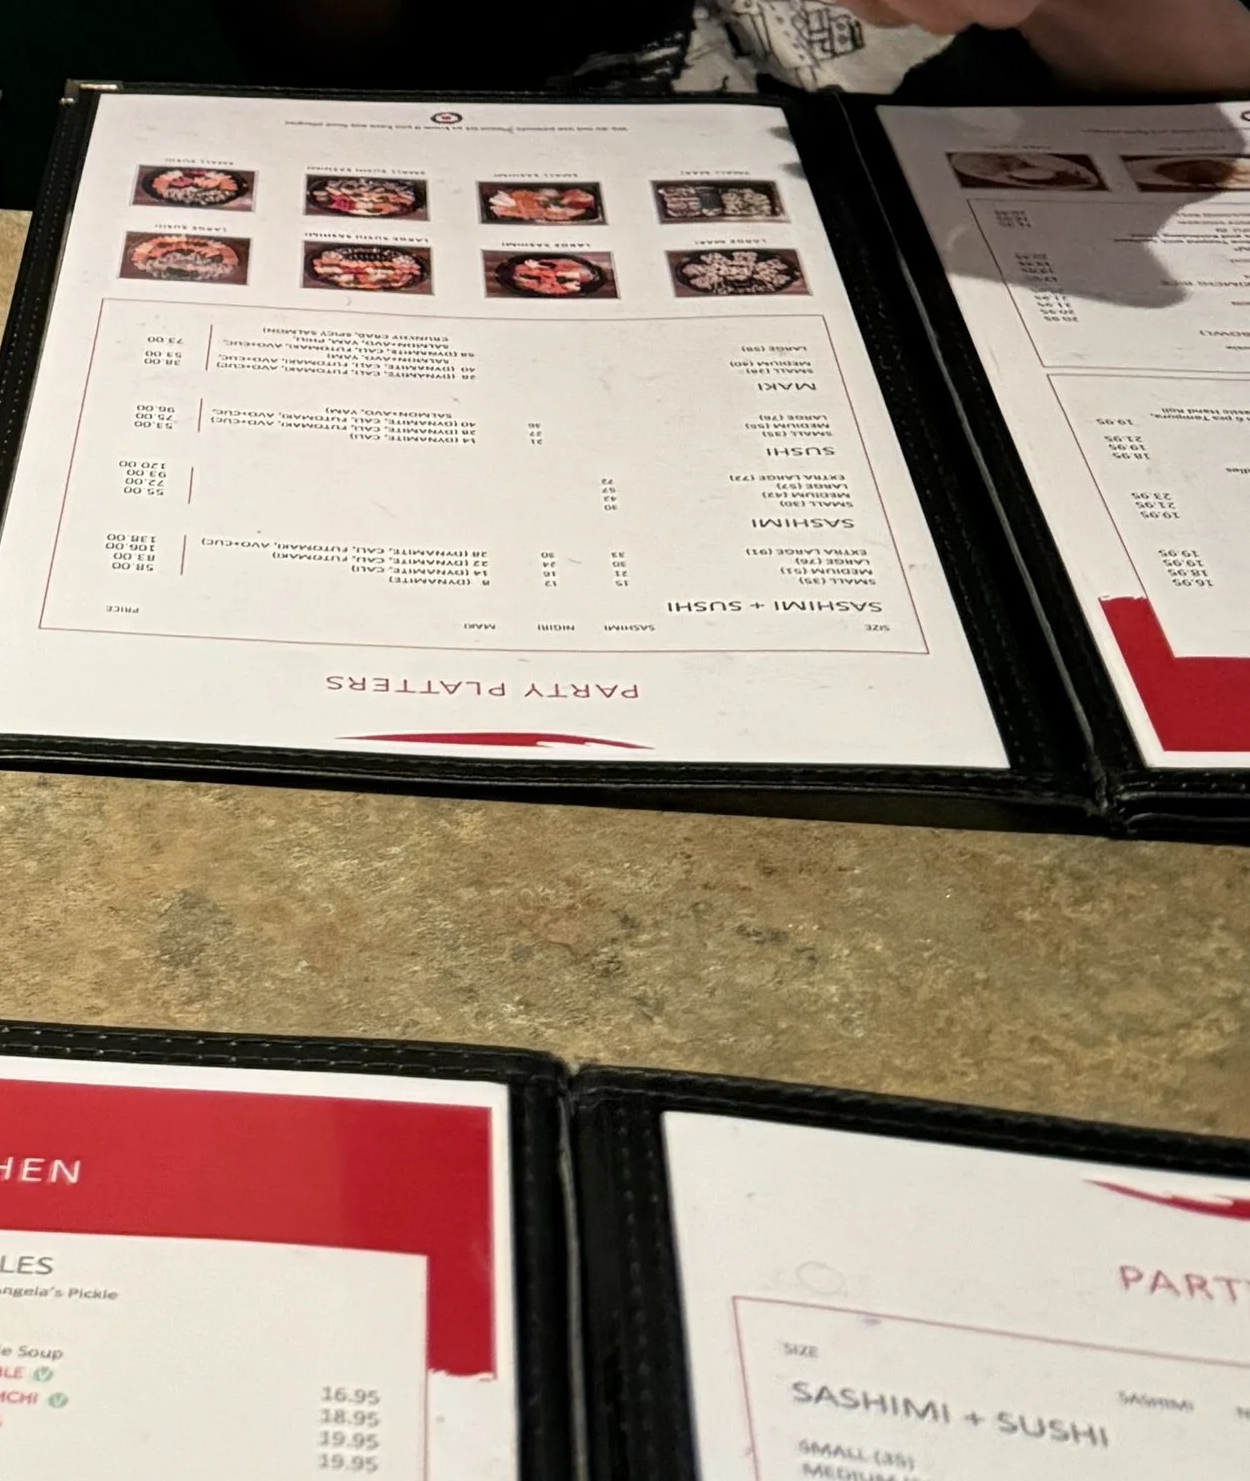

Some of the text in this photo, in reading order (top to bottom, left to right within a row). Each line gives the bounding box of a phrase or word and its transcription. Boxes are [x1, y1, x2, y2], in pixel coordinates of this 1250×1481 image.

[757, 382, 817, 392] MAKI
[766, 447, 835, 457] SUSHI
[752, 518, 855, 529] SASHIMI
[668, 601, 742, 612] SUSHI
[774, 601, 883, 613] SASHIMI
[604, 624, 656, 632] SASHIMI
[865, 624, 891, 632] SIZE
[326, 676, 639, 699] PARTY PLATTERS
[67, 1287, 119, 1300] Pickle
[1119, 1265, 1250, 1305] PART
[17, 1344, 64, 1361] Soup
[783, 1342, 818, 1358] SIZE
[321, 1385, 381, 1406] 16.95
[1118, 1391, 1194, 1411] SASHIMI
[320, 1408, 381, 1428] 18.95
[791, 1380, 950, 1424] SASHIMI
[996, 1410, 1109, 1448] SUSHI
[319, 1430, 380, 1451] 19.95
[798, 1438, 867, 1461] SMALL
[318, 1453, 379, 1474] 19.95
